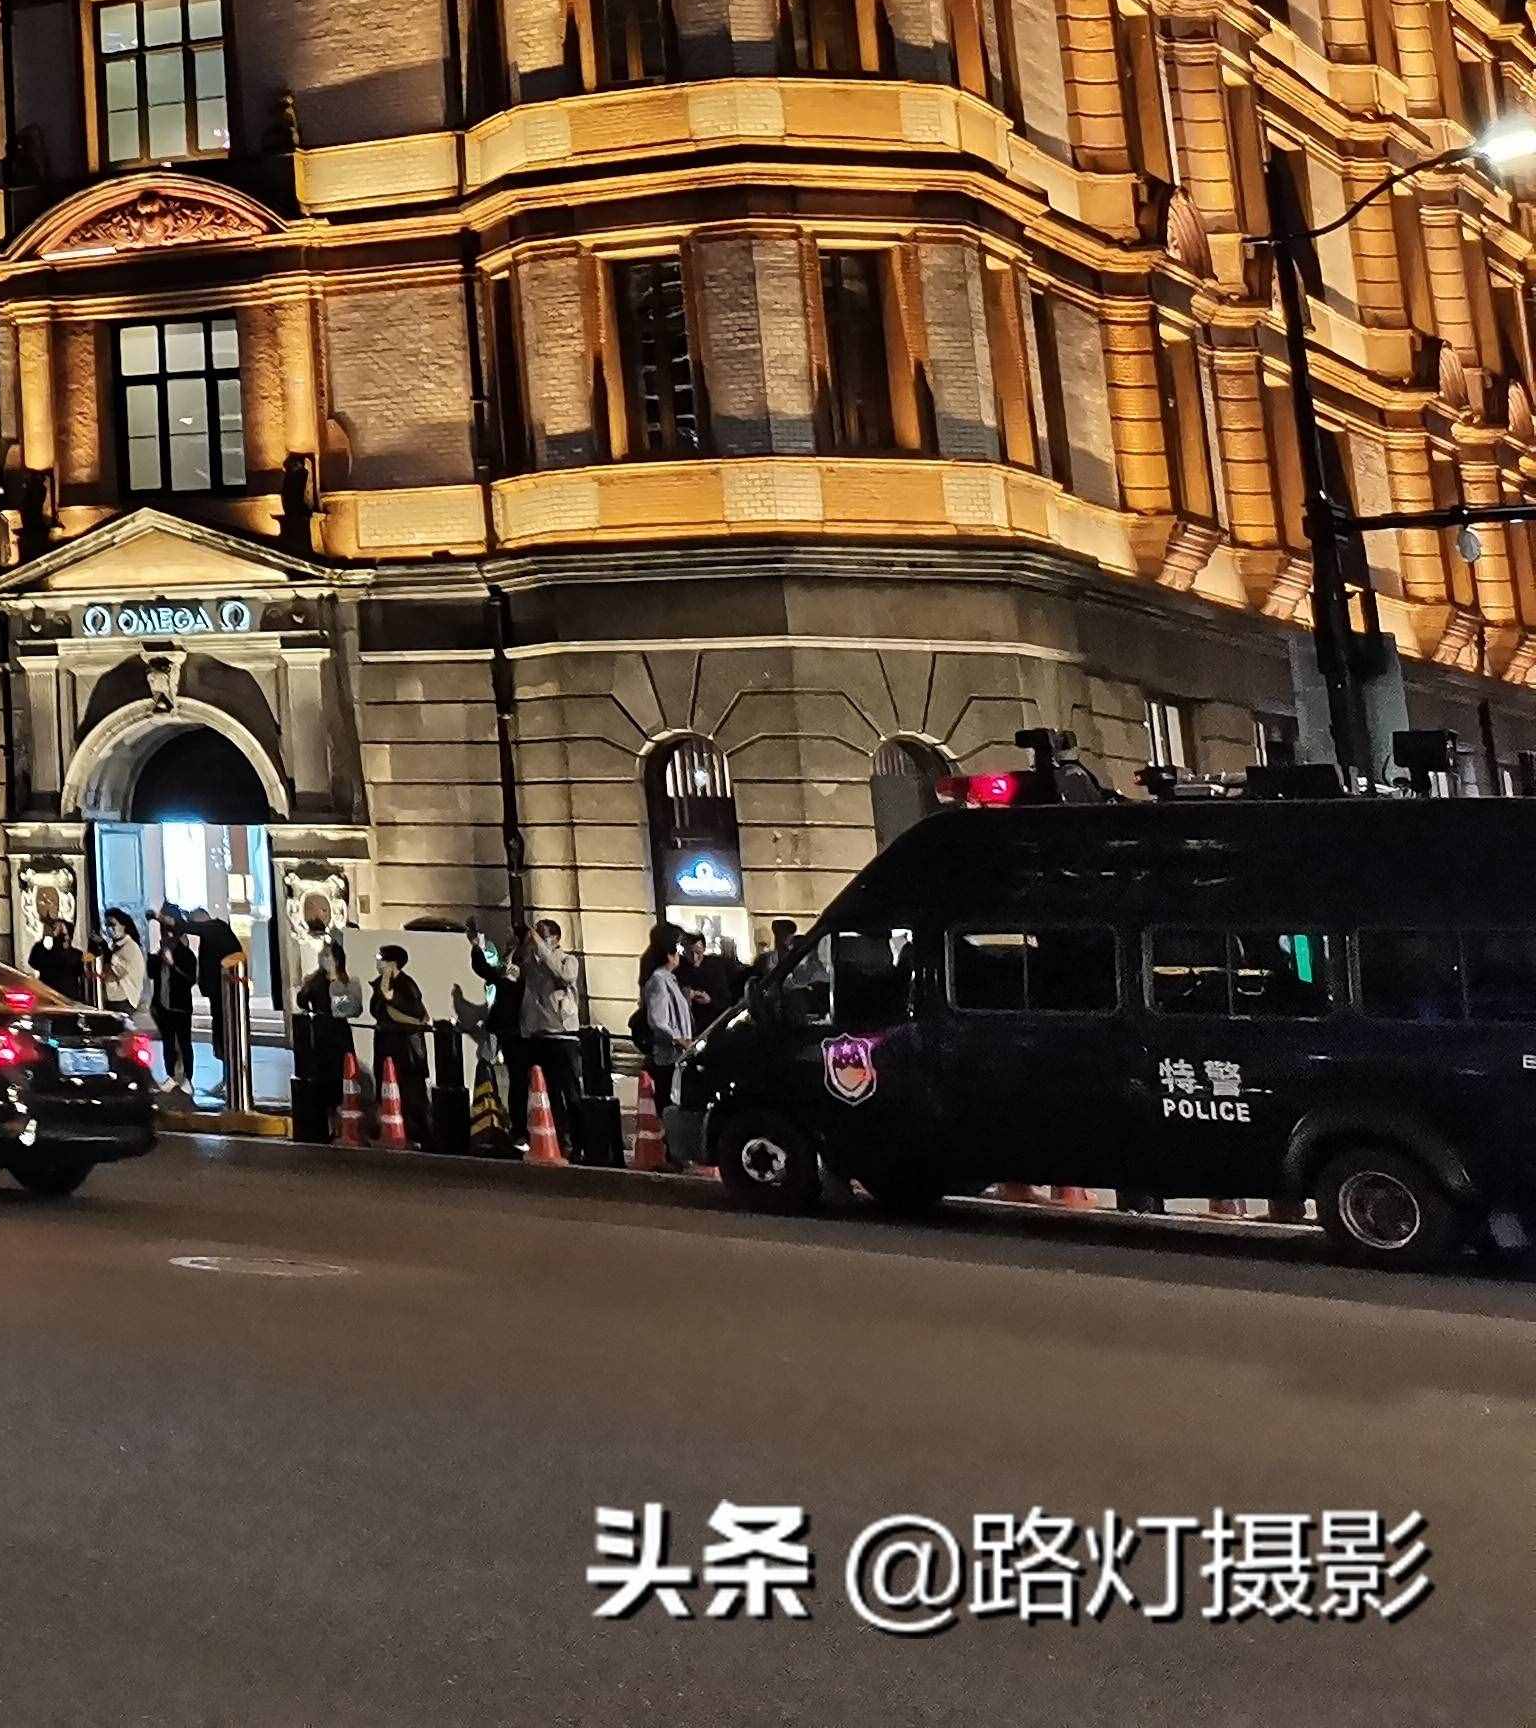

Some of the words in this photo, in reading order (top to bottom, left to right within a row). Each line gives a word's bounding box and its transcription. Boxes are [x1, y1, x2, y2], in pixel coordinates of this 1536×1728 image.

[118, 606, 215, 635] OMEGA
[1159, 1058, 1242, 1097] 特警
[1162, 1098, 1250, 1122] POLICE
